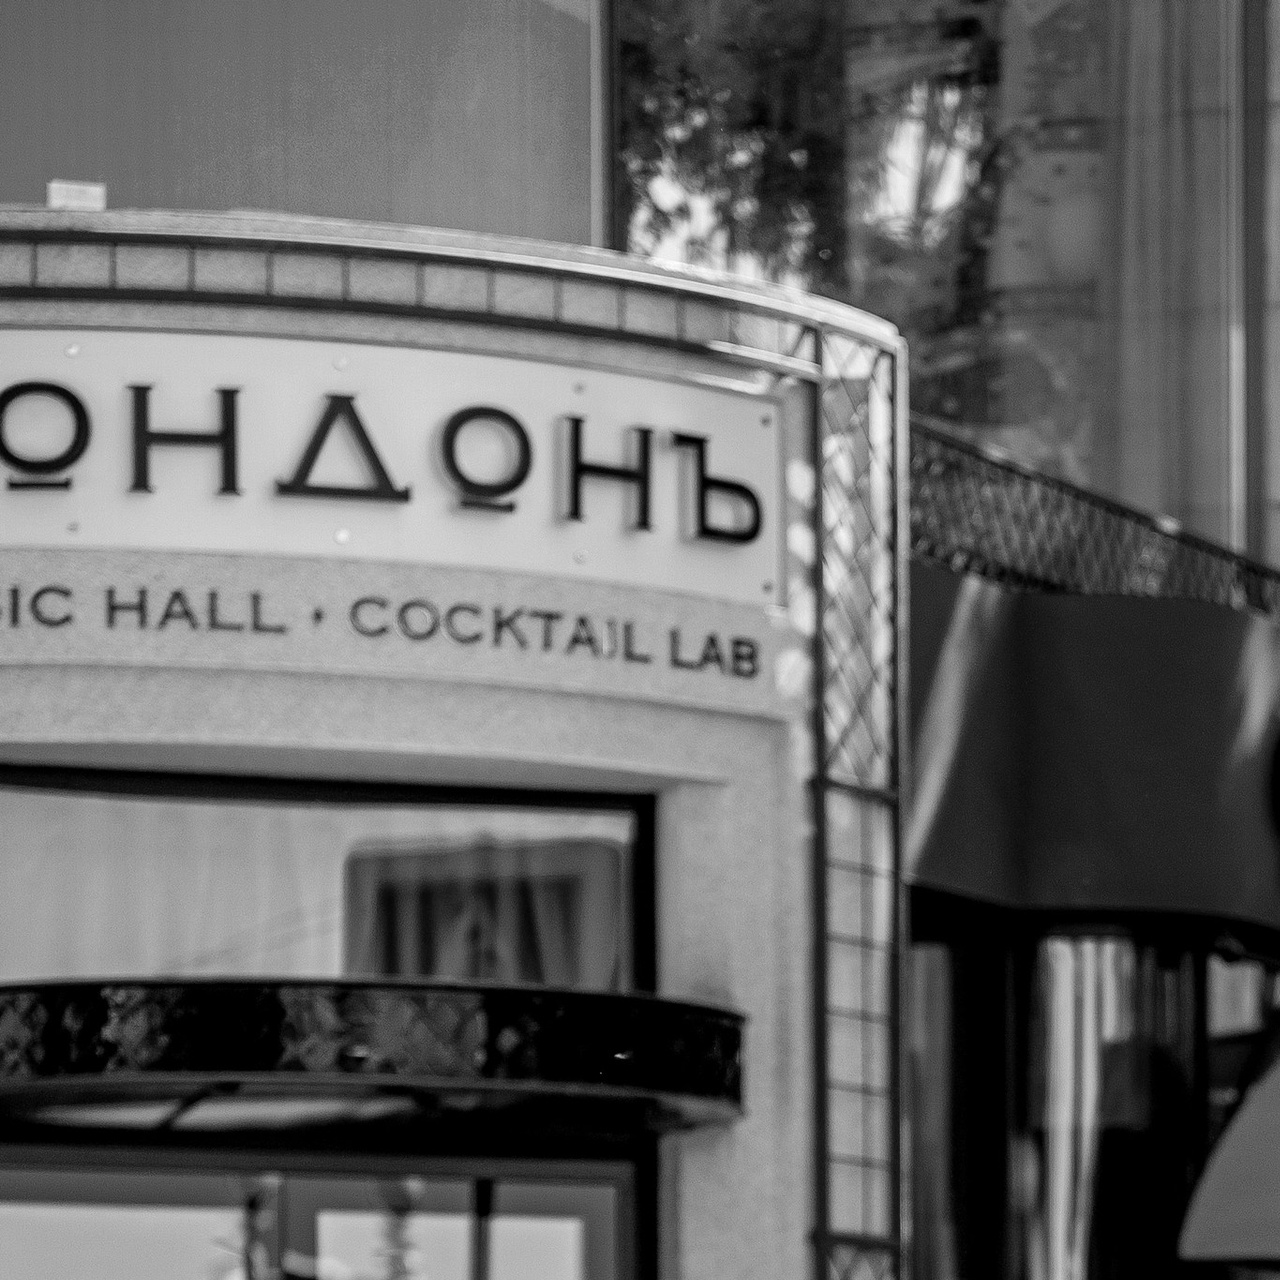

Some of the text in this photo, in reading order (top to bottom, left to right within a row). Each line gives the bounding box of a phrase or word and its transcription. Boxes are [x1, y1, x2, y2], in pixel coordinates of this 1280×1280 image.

[0, 583, 762, 681] IC HALL COCKTAIL LAB
